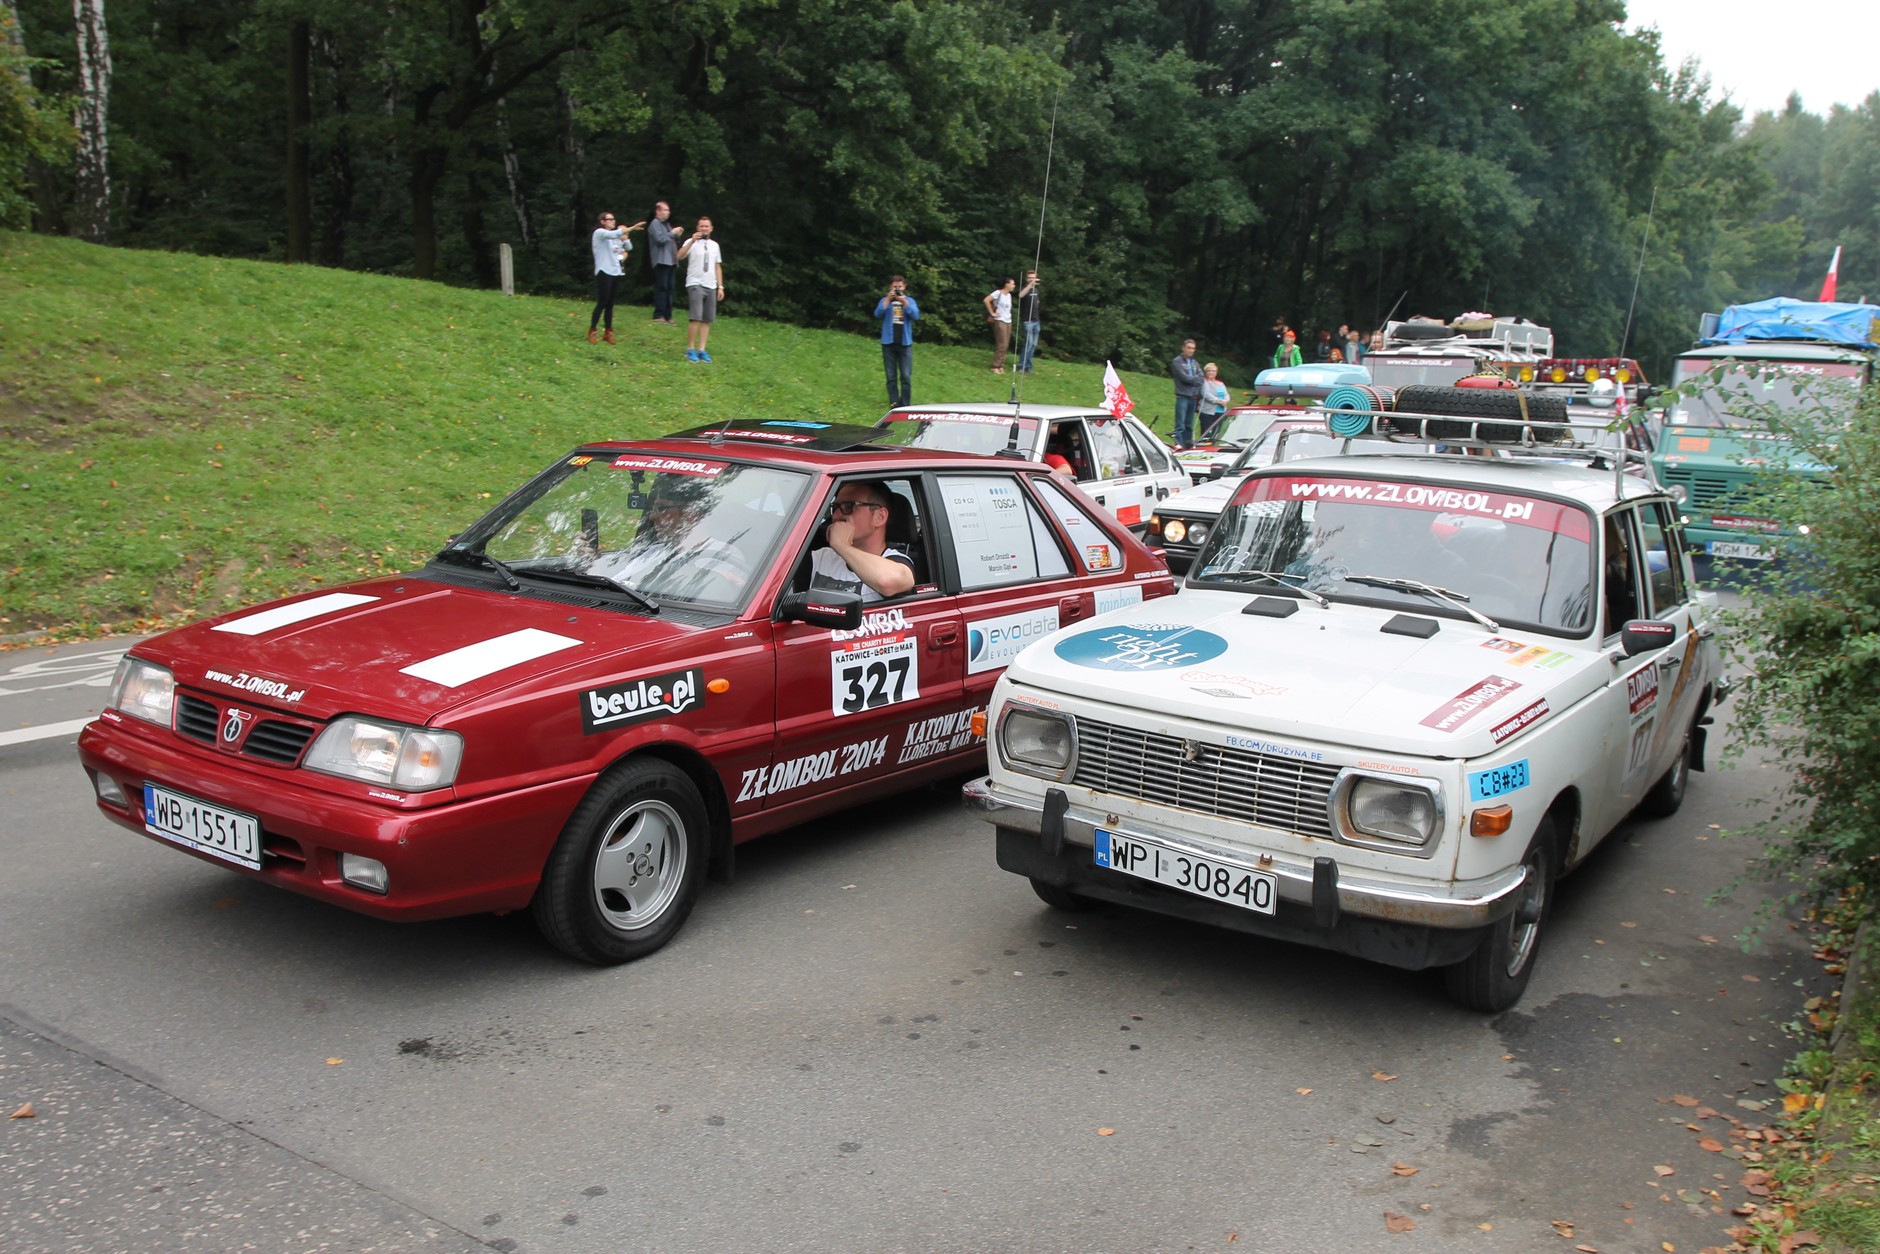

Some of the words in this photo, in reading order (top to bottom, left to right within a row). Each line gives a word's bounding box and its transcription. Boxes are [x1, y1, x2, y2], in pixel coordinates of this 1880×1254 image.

[907, 412, 1013, 426] www.ZLOMBOL.p
[615, 458, 723, 476] www.ZLOMBOL.pl
[992, 498, 1018, 510] TOSCA
[1291, 482, 1535, 520] www.ZLOMBOL.pl
[861, 638, 883, 649] CHARITY
[882, 636, 897, 645] RALLY
[990, 615, 1058, 644] evodata
[900, 642, 914, 651] MAR
[205, 669, 306, 703] www.ZLOMBOL.pl
[588, 670, 696, 710] beule.pl
[842, 656, 910, 713] 327
[949, 731, 971, 751] MAR
[735, 748, 840, 804] ZŁOMBOL
[156, 793, 184, 831] WB
[191, 806, 254, 854] 1551J
[1097, 851, 1109, 862] PL
[1112, 838, 1160, 879] WPI
[1176, 856, 1272, 909] 30840
